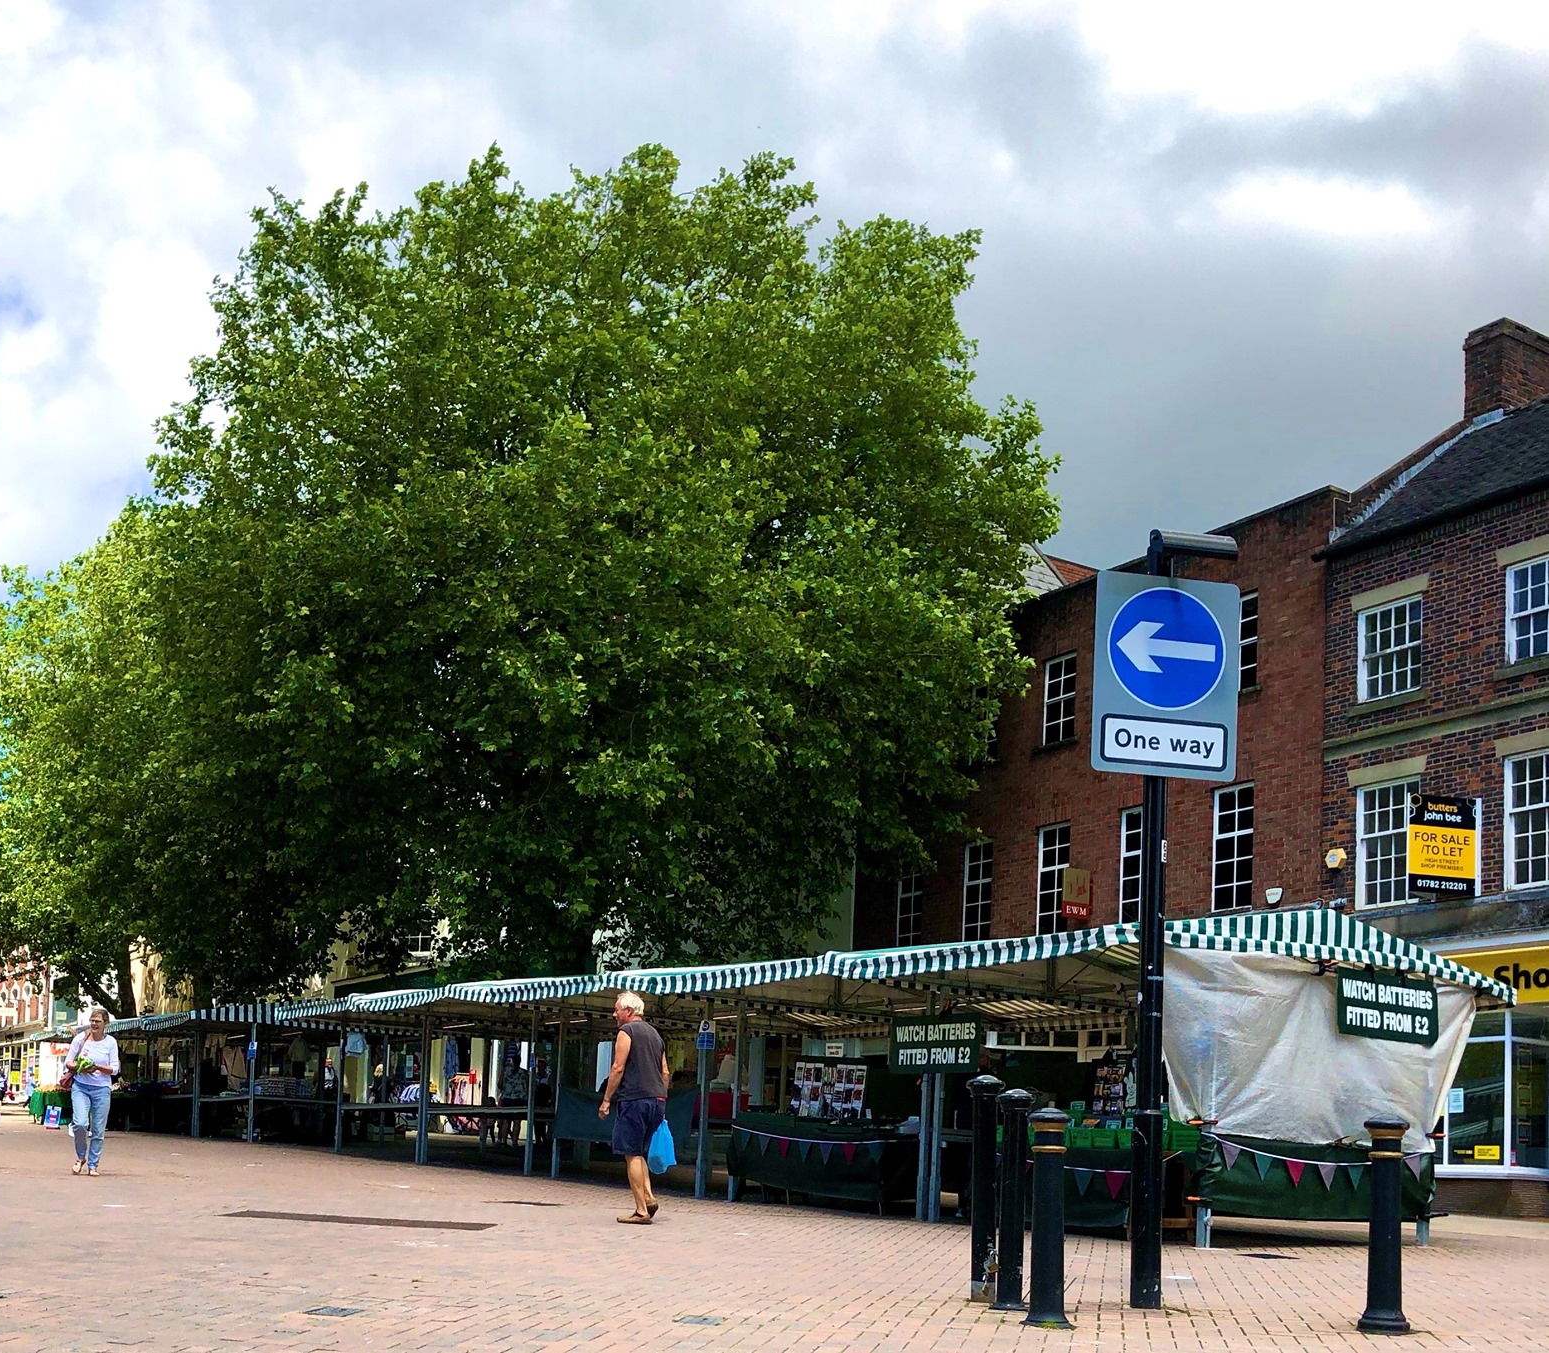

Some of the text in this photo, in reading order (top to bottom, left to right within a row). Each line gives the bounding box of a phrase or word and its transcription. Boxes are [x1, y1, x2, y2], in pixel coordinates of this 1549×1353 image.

[1114, 728, 1215, 759] One way
[1427, 802, 1458, 813] butters
[1423, 811, 1462, 823] john bee
[1414, 832, 1470, 846] FOR SALE
[1421, 845, 1463, 857] /TO LET
[1417, 879, 1467, 890] 01782 212201
[1066, 905, 1087, 916] EWM
[1342, 978, 1433, 1010] WATCH BATTERIES
[1346, 1005, 1429, 1035] FITTED FROM £2
[896, 1022, 976, 1042] WATCH BATTERIES
[898, 1046, 971, 1065] FITTED FROM £2
